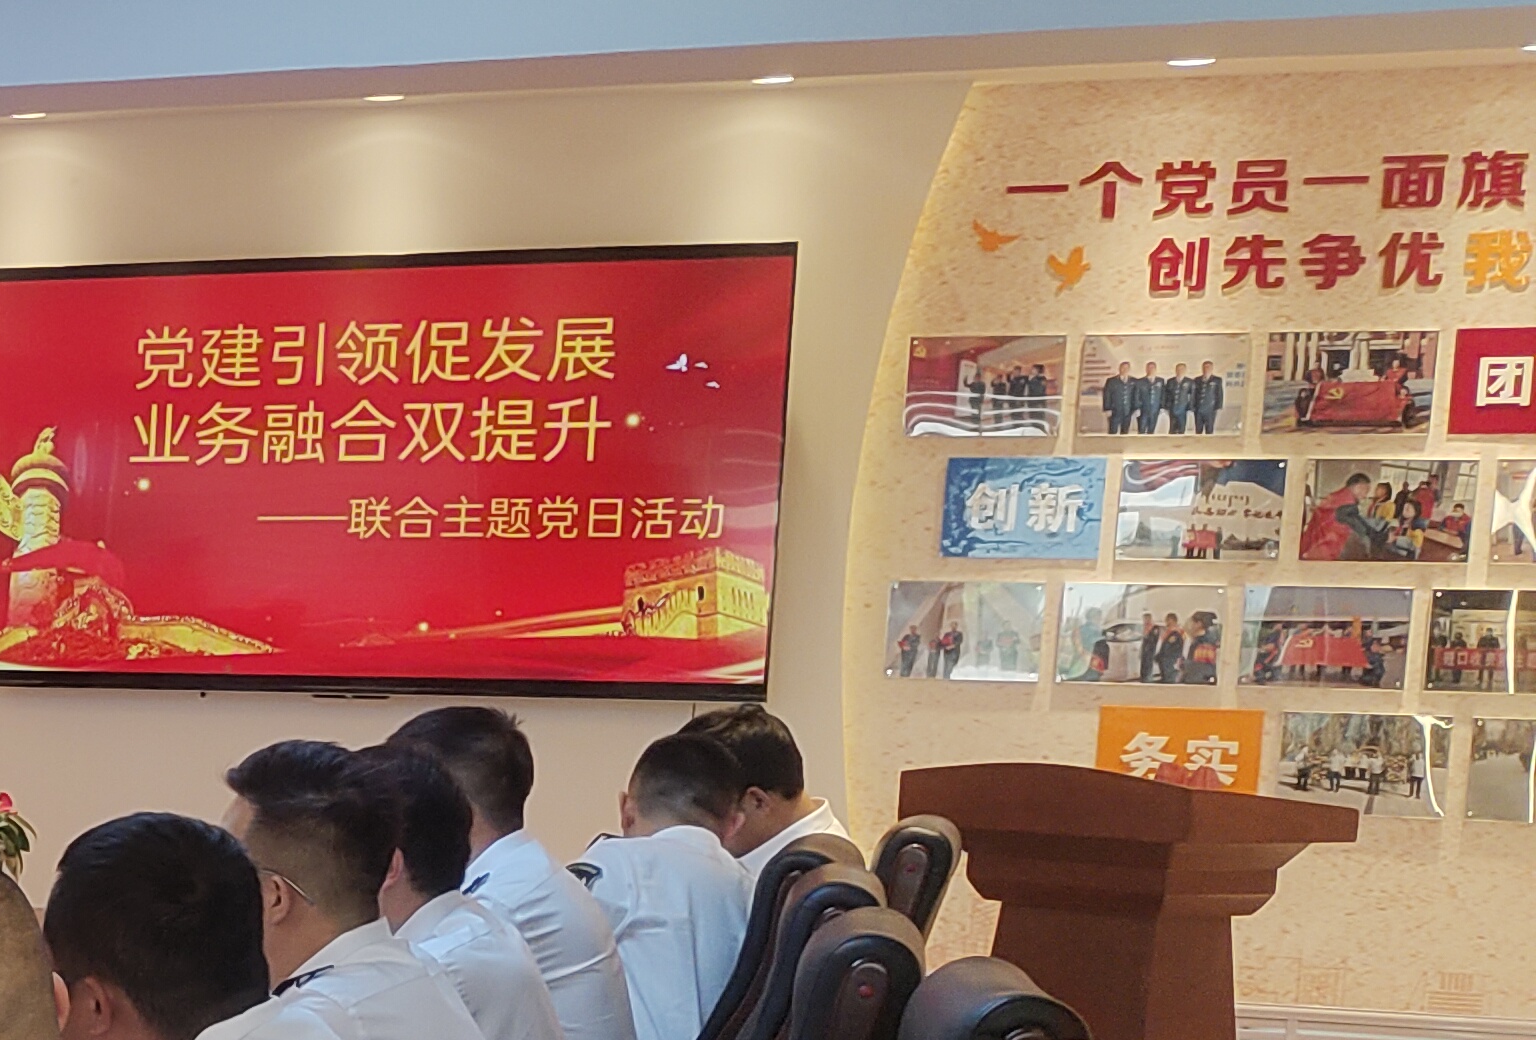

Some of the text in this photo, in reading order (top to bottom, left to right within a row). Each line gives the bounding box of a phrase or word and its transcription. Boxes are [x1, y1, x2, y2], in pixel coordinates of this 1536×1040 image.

[1006, 150, 1529, 219] 一个党员一面旗
[135, 317, 615, 390] 党建引领促发展
[1476, 356, 1533, 407] 团
[129, 396, 611, 466] 业务融合双提升
[966, 481, 1084, 535] 创新
